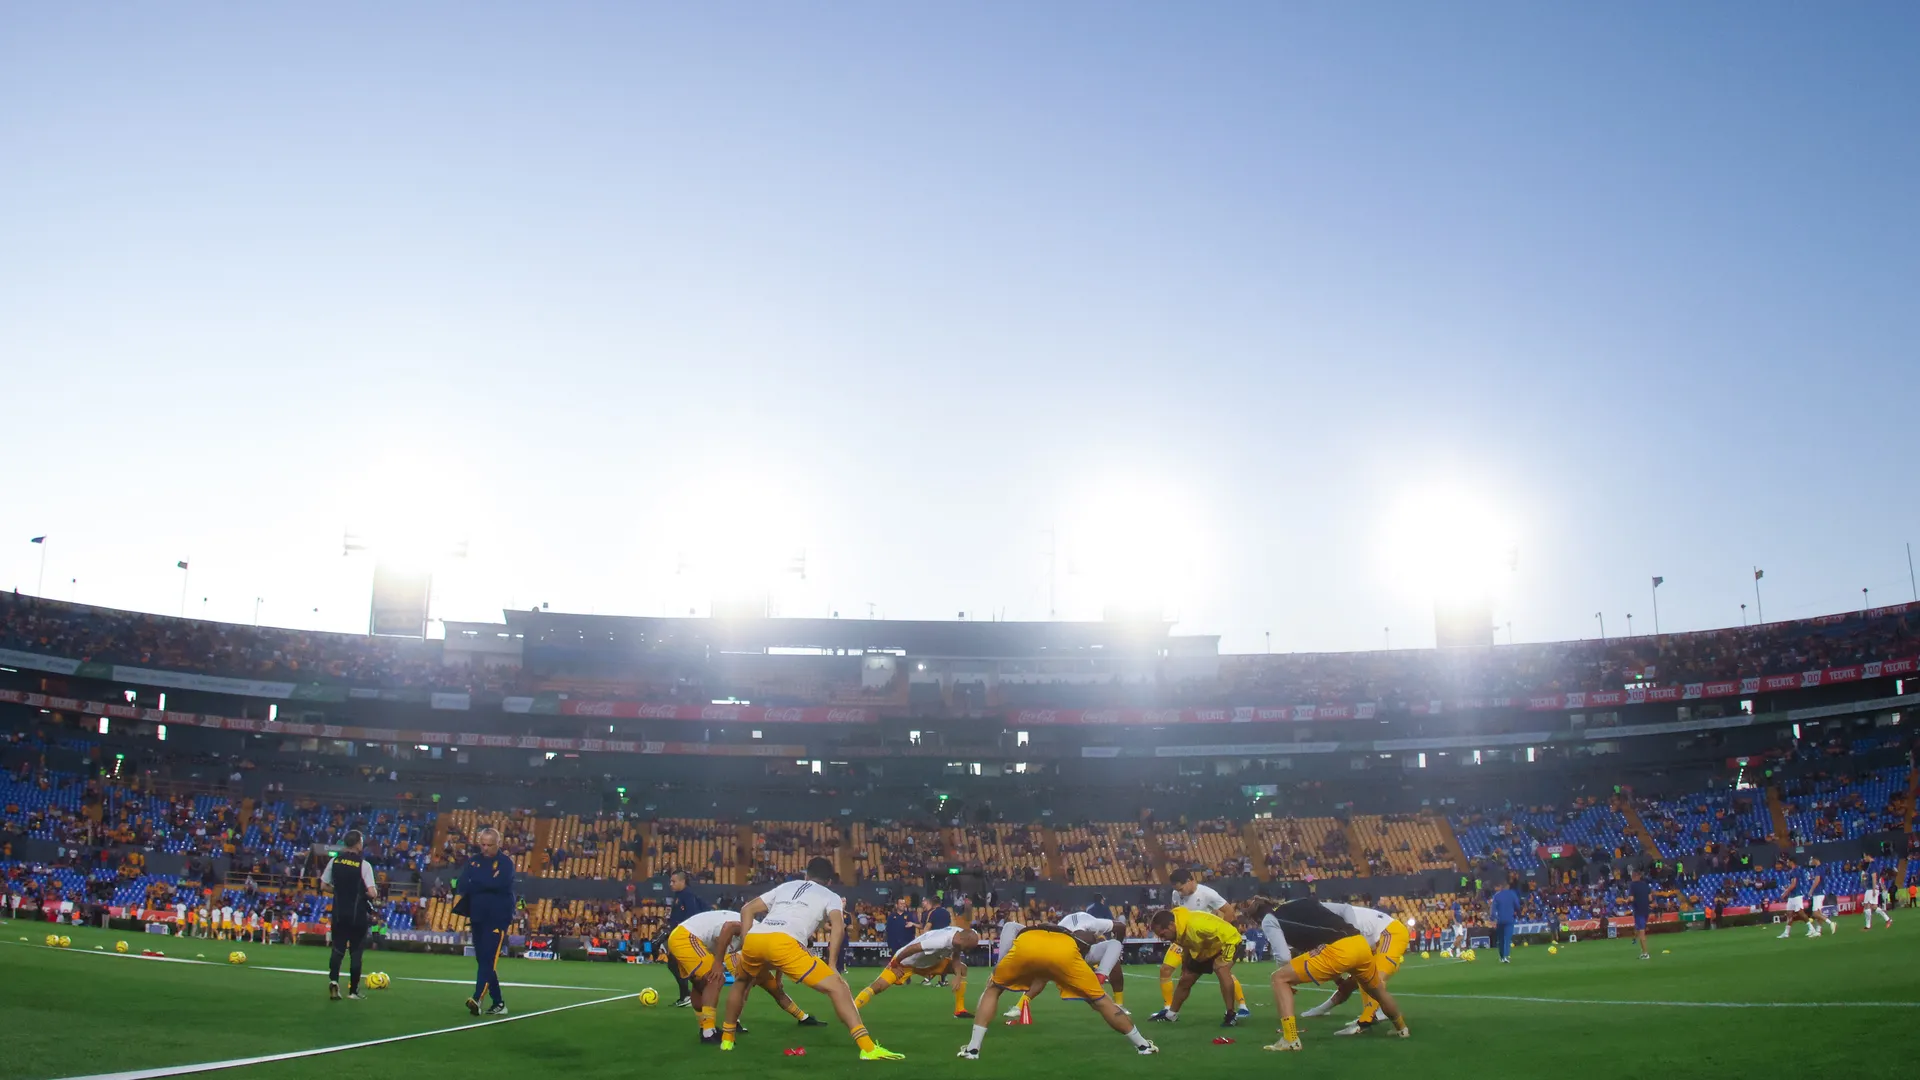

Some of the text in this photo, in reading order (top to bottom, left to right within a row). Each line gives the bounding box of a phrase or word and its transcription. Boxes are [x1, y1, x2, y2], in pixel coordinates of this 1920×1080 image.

[1884, 660, 1911, 673] TECATE
[1829, 668, 1856, 681] TECATE
[1767, 675, 1796, 688] TECATE
[1648, 688, 1676, 700] TECATE
[1706, 683, 1734, 695] TECATE
[1530, 697, 1558, 707] TECATE
[1592, 692, 1620, 704] TECATE
[1195, 710, 1225, 721] TECATE
[1320, 706, 1348, 718] TECATE
[481, 735, 512, 747] TECATE
[605, 740, 636, 752] TECATE
